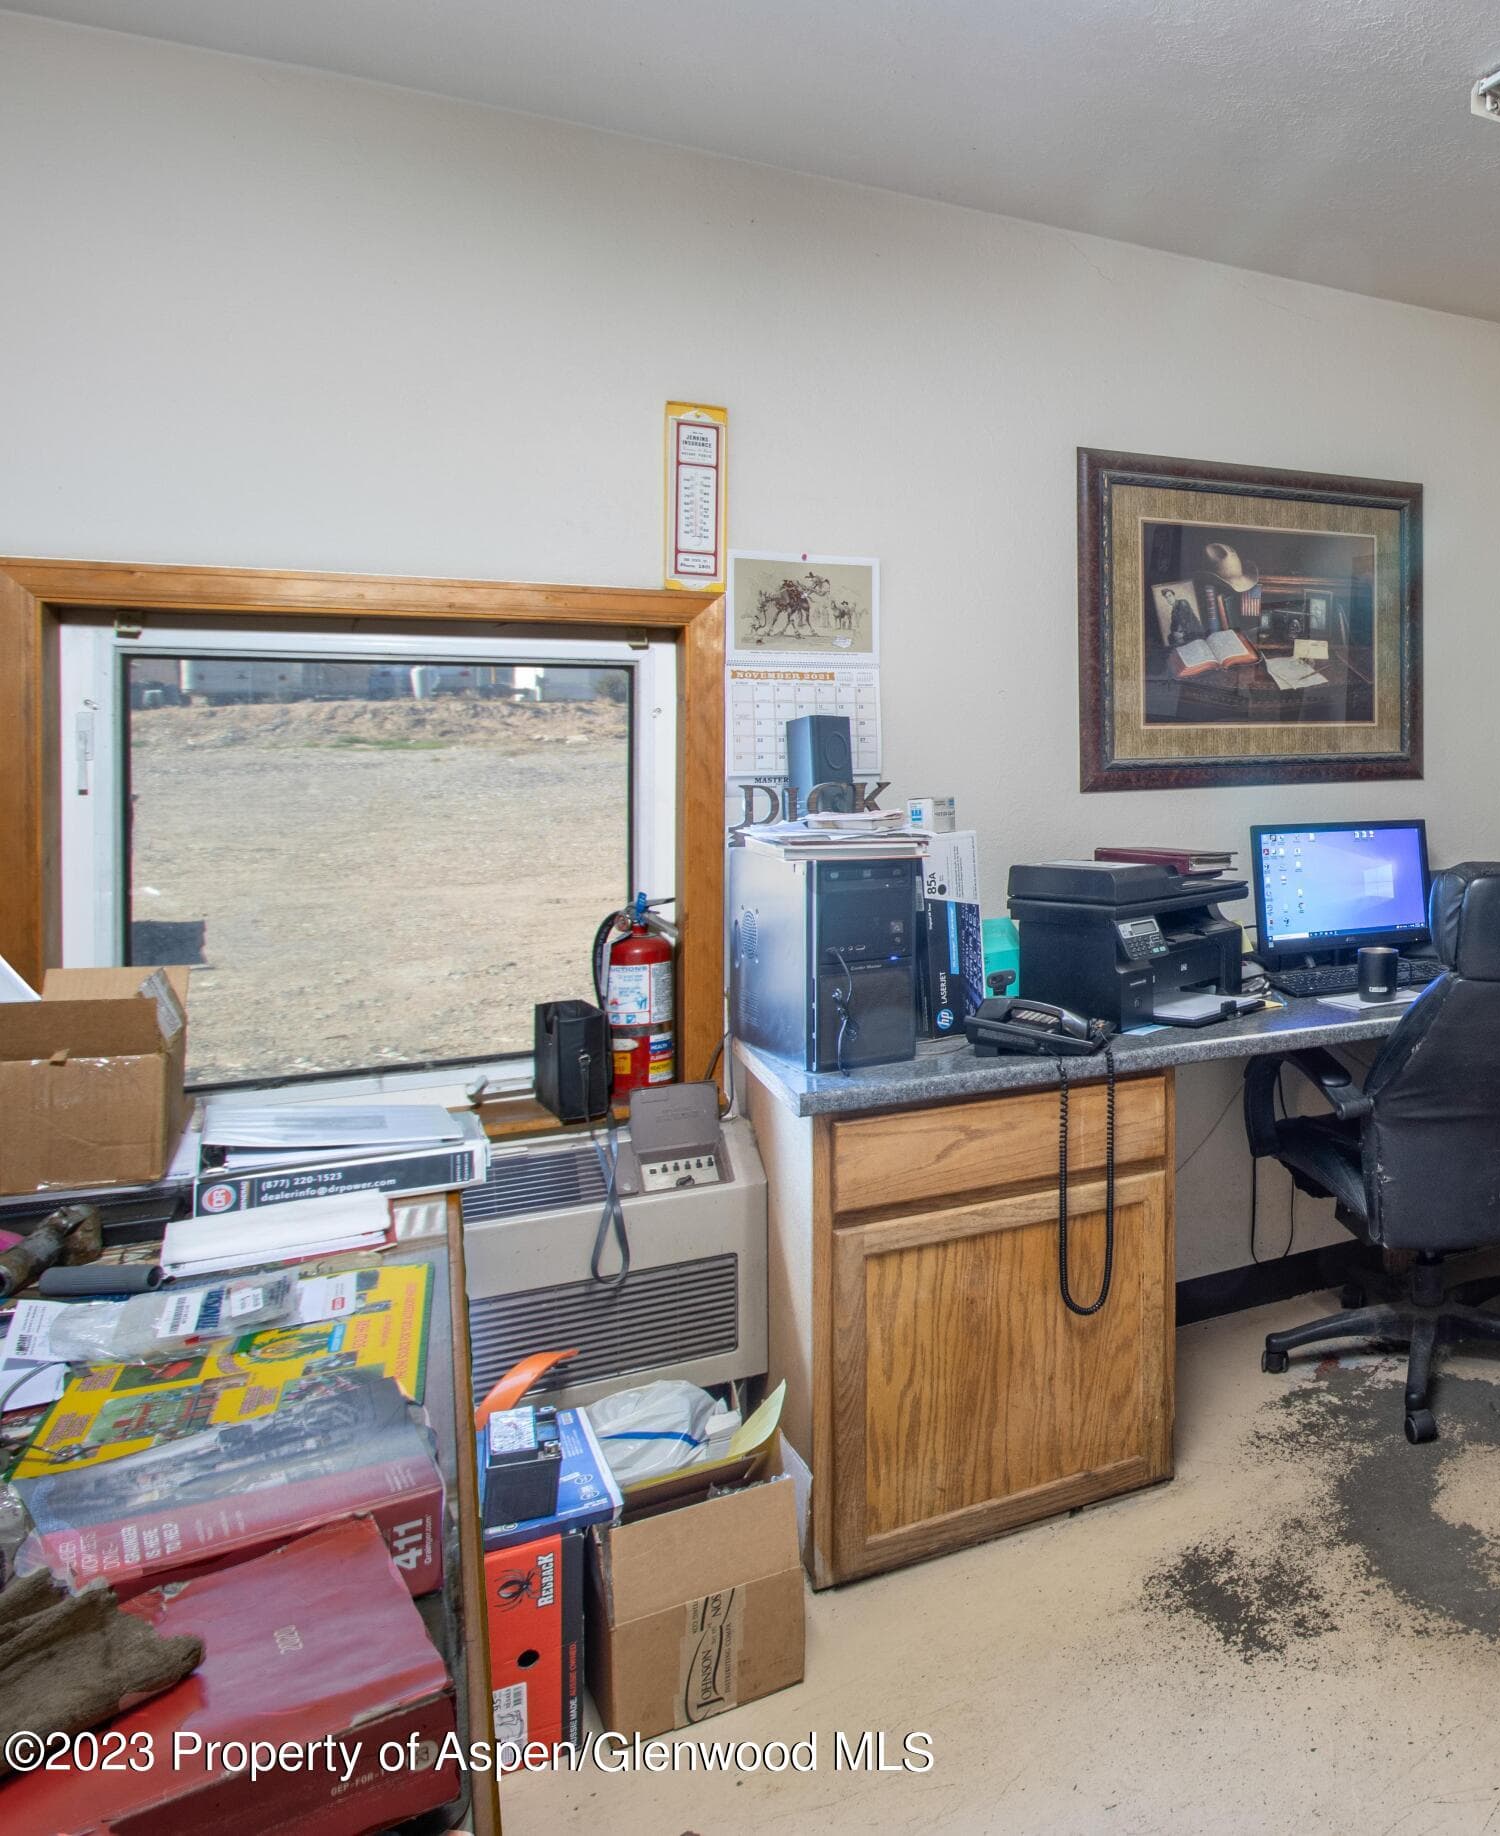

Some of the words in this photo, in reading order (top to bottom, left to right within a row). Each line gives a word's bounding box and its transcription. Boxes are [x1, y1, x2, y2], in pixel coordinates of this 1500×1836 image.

[682, 440, 712, 448] INSURANCE
[736, 671, 800, 679] NOVEMBER
[732, 781, 891, 828] DICK
[927, 871, 937, 894] 85A
[938, 1010, 953, 1029] hp
[261, 1176, 290, 1191] (877)
[294, 1172, 343, 1185] 220-1523
[261, 1177, 396, 1202] dealerinfo@drpower.com
[394, 1517, 424, 1571] 411
[424, 1513, 434, 1568] Grainger.com
[696, 1649, 725, 1714] JOHNSON
